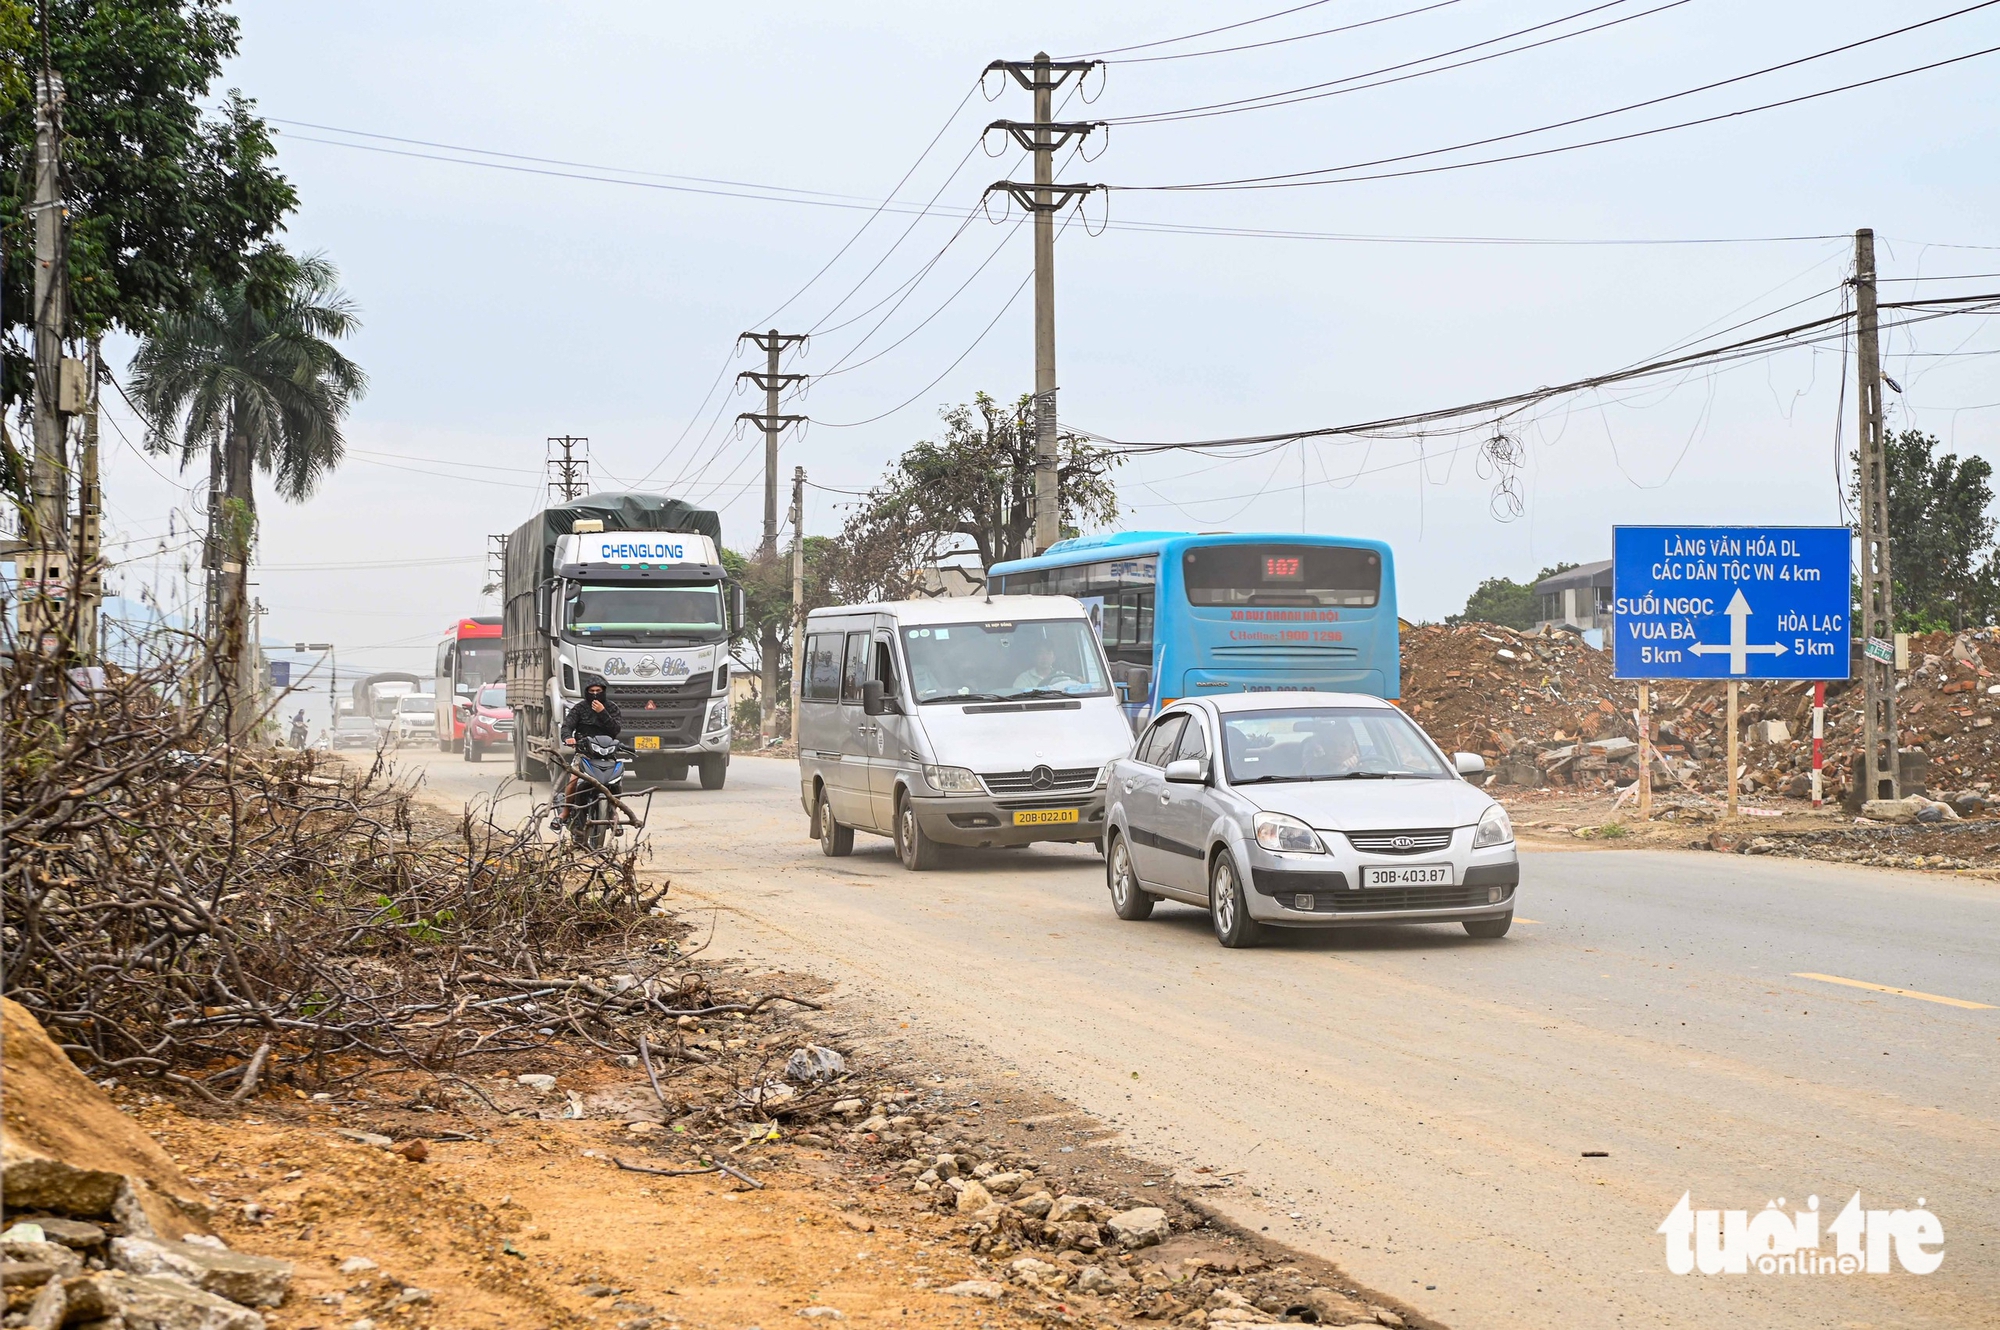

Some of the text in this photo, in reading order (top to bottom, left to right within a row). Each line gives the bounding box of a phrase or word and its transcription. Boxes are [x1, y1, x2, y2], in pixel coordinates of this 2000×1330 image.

[601, 544, 683, 558] CHENGLONG
[1664, 534, 1800, 557] LÀNG VĂN HÓA DL
[1266, 558, 1299, 575] 107
[1652, 558, 1821, 585] CÁC DÂN TỘC VN 4 km
[1616, 590, 1714, 619] SUỐI NGỌC
[1246, 610, 1264, 621] BUS
[1266, 610, 1302, 621] NHANH
[1303, 609, 1318, 621] HÀ
[1319, 609, 1339, 622] NỘI
[1778, 609, 1842, 635] HÒA LẠC
[1238, 630, 1278, 641] Hotline:
[1279, 630, 1310, 641] 1900
[1628, 616, 1697, 640] VUA BÀ
[1641, 646, 1682, 664] 5 km
[1794, 638, 1835, 656] 5 km
[1019, 811, 1073, 823] 20B-022.01
[1395, 838, 1412, 846] KIA
[1371, 868, 1446, 883] 30B-403.87
